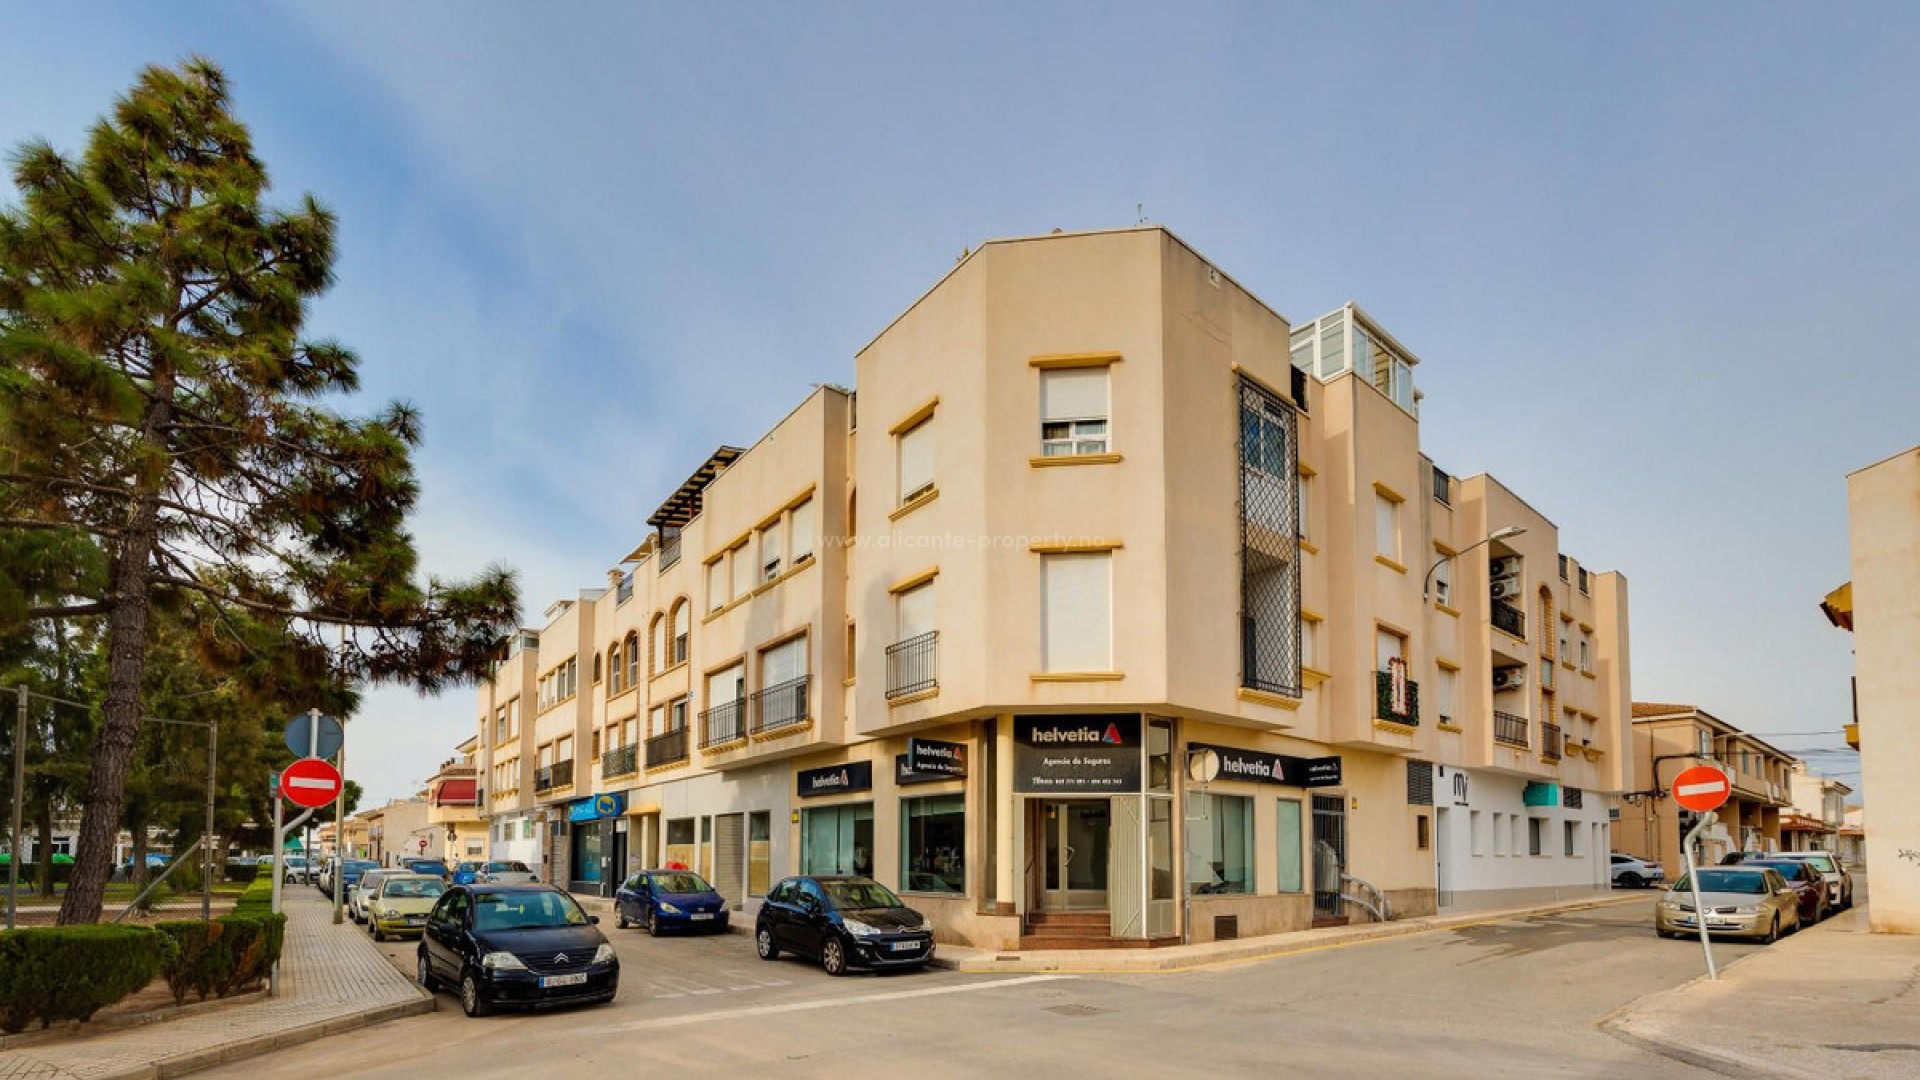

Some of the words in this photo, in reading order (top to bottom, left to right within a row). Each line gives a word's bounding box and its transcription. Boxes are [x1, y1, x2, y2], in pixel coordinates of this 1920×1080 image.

[1032, 727, 1100, 742] helvetia
[916, 744, 953, 759] helvetia
[1224, 756, 1270, 777] helvetia
[812, 773, 840, 789] helvetia
